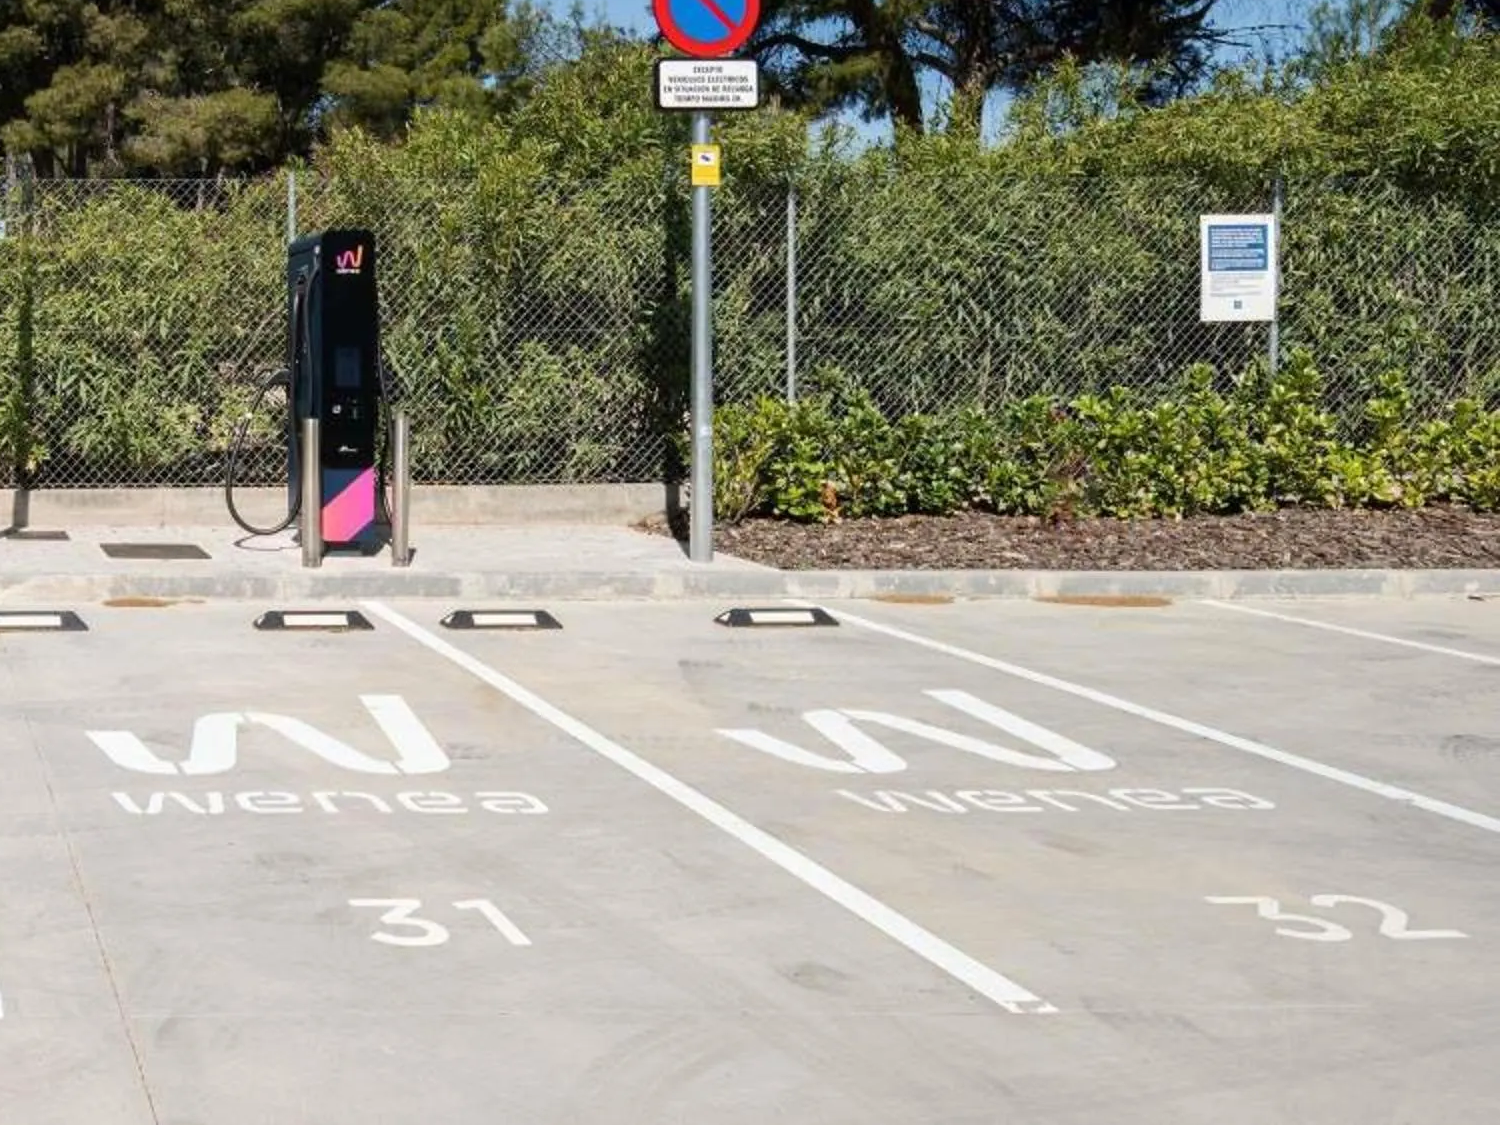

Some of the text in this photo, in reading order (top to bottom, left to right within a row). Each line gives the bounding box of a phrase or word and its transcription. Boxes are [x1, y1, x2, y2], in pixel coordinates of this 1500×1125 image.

[110, 791, 551, 815] wenea
[834, 787, 1278, 814] wenea
[348, 898, 534, 947] 31
[1202, 894, 1472, 942] 32
